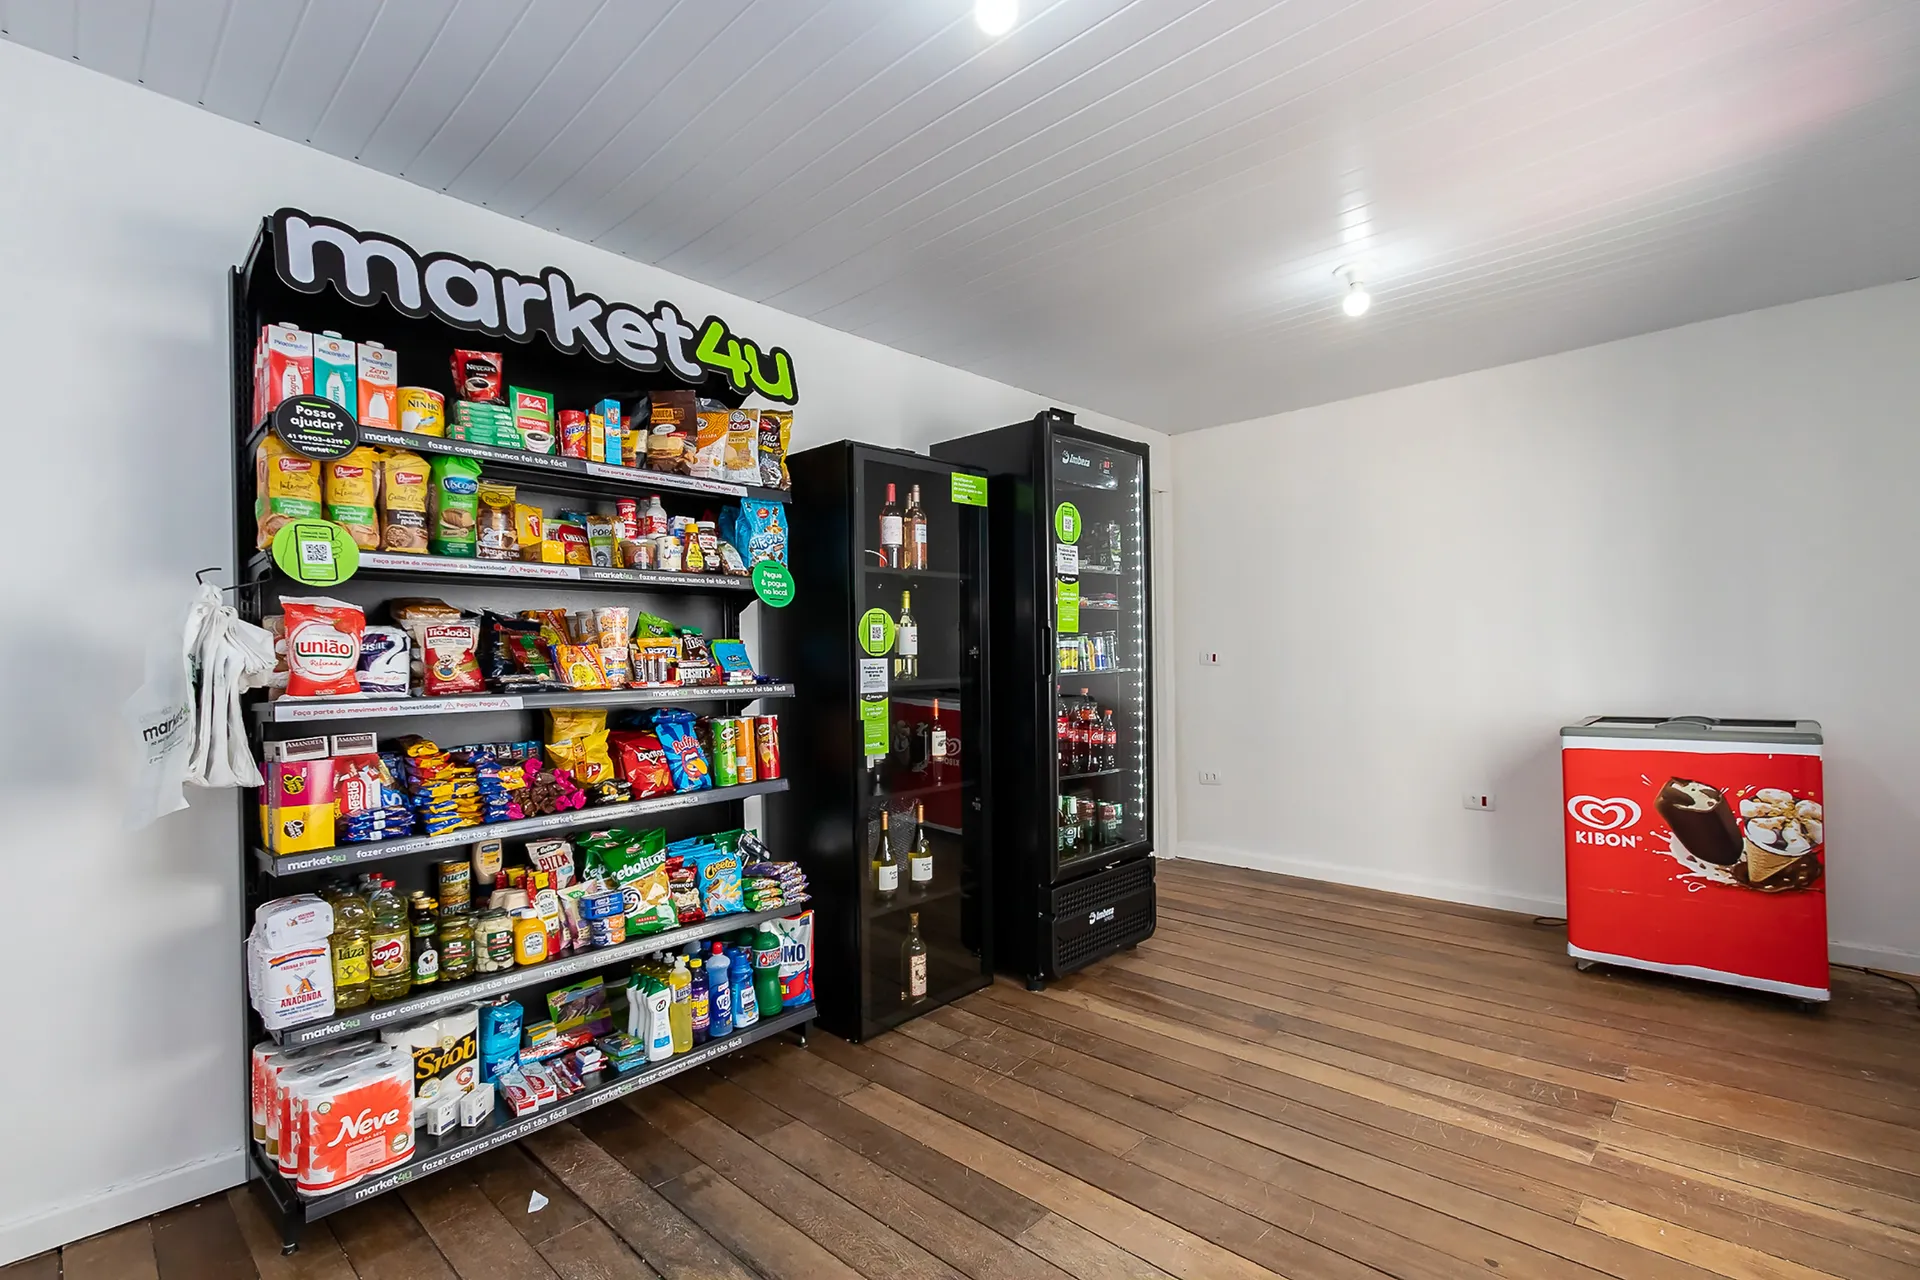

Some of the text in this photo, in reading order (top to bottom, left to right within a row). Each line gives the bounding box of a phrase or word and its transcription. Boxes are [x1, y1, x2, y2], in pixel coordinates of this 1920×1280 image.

[286, 216, 792, 399] market4u
[295, 404, 337, 420] Posso
[407, 399, 440, 412] NINHO
[290, 416, 344, 431] ajudar?
[364, 431, 567, 468] market4u fazer compras nunca foi tão fácil
[760, 578, 788, 589] & pague
[762, 570, 783, 579] Pegue
[763, 587, 788, 597] no local
[427, 628, 443, 637] Tio
[299, 639, 350, 655] união
[293, 709, 312, 719] Faça
[313, 708, 334, 717] parte
[347, 706, 388, 714] movimento
[399, 702, 442, 712] honestidade!
[479, 700, 499, 709] Pagou
[286, 739, 323, 749] AMANDITA
[338, 735, 373, 743] AMANDITA
[1575, 830, 1637, 849] KIBON
[287, 846, 383, 871] market4u fazer
[539, 853, 570, 872] PIZZA
[441, 870, 468, 883] Quero
[704, 858, 737, 879] Cheetos
[337, 945, 366, 961] Liza
[371, 945, 399, 961] Soya
[780, 943, 806, 963] MO
[280, 990, 322, 1008] ANACONDA
[301, 973, 523, 1042] market4u fazer compras nunca foi tão fácil
[415, 1035, 476, 1079] Snob
[591, 1037, 743, 1105] market4u fazer compras nunca foi tão fácil
[327, 1108, 400, 1147] Neve
[355, 1108, 568, 1200] market4u fazer compras nunca foi tão fácil
